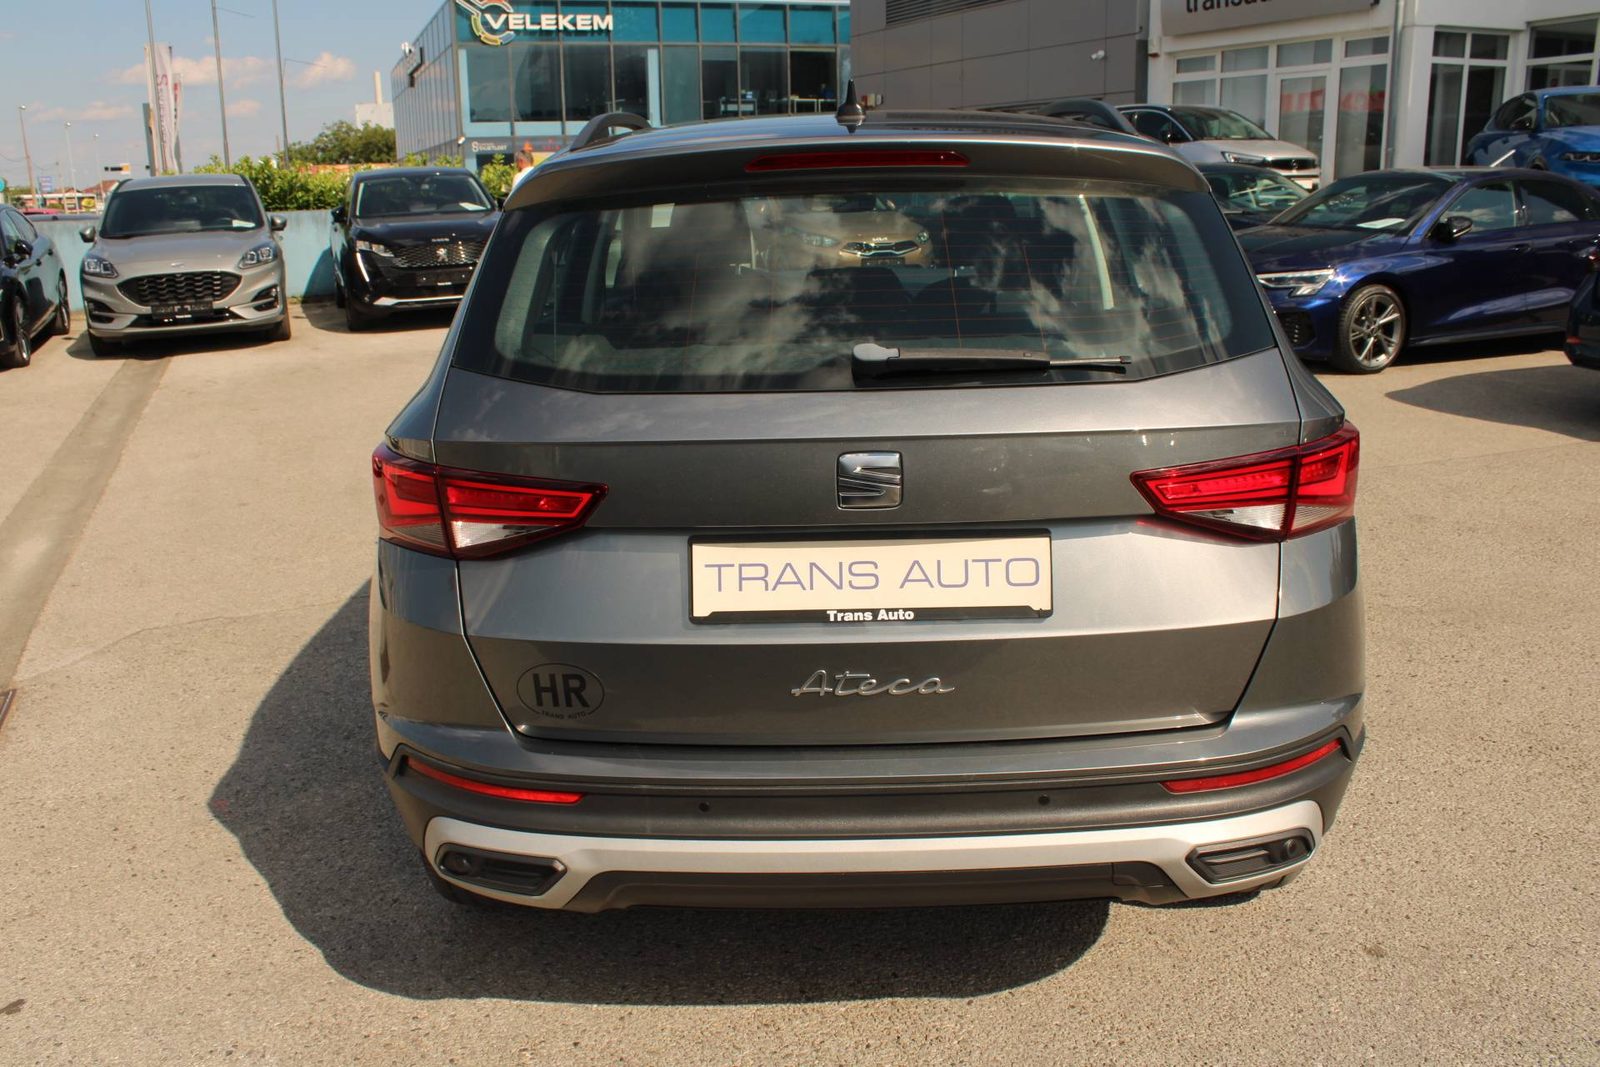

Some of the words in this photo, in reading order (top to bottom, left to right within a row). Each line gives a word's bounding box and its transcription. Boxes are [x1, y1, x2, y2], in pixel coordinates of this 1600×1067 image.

[484, 13, 614, 31] VELEKEM
[704, 560, 881, 593] TRANS
[899, 557, 1041, 589] AUTO
[826, 610, 874, 622] Trans
[877, 608, 915, 621] Auto
[532, 673, 590, 708] HR
[791, 669, 956, 698] Ateca
